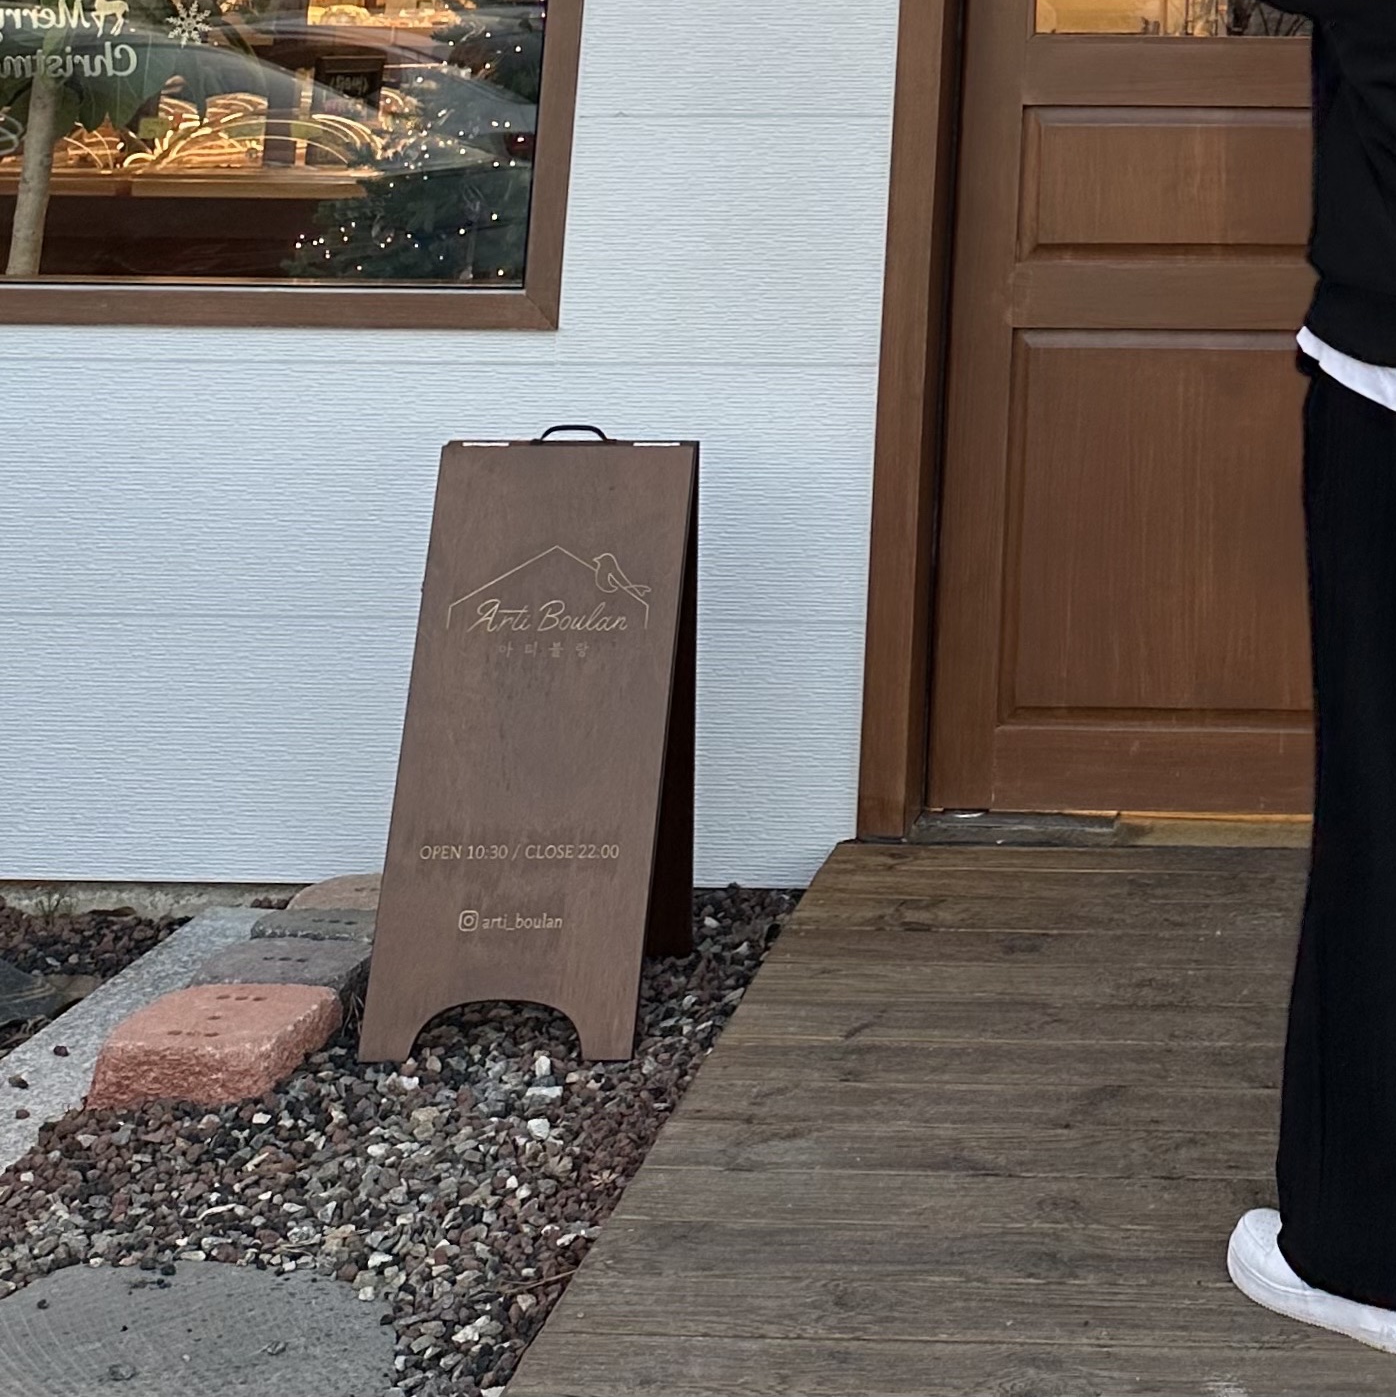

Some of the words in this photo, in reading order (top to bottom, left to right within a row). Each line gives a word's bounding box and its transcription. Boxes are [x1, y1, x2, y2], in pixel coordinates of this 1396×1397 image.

[467, 599, 531, 632] Arti
[537, 600, 628, 632] Boulan
[419, 844, 462, 860] OPEN
[466, 845, 508, 860] 10:30
[511, 844, 521, 861] /
[525, 844, 575, 859] CLOSE
[577, 844, 620, 859] 22:00
[482, 913, 563, 931] arti_boulan
